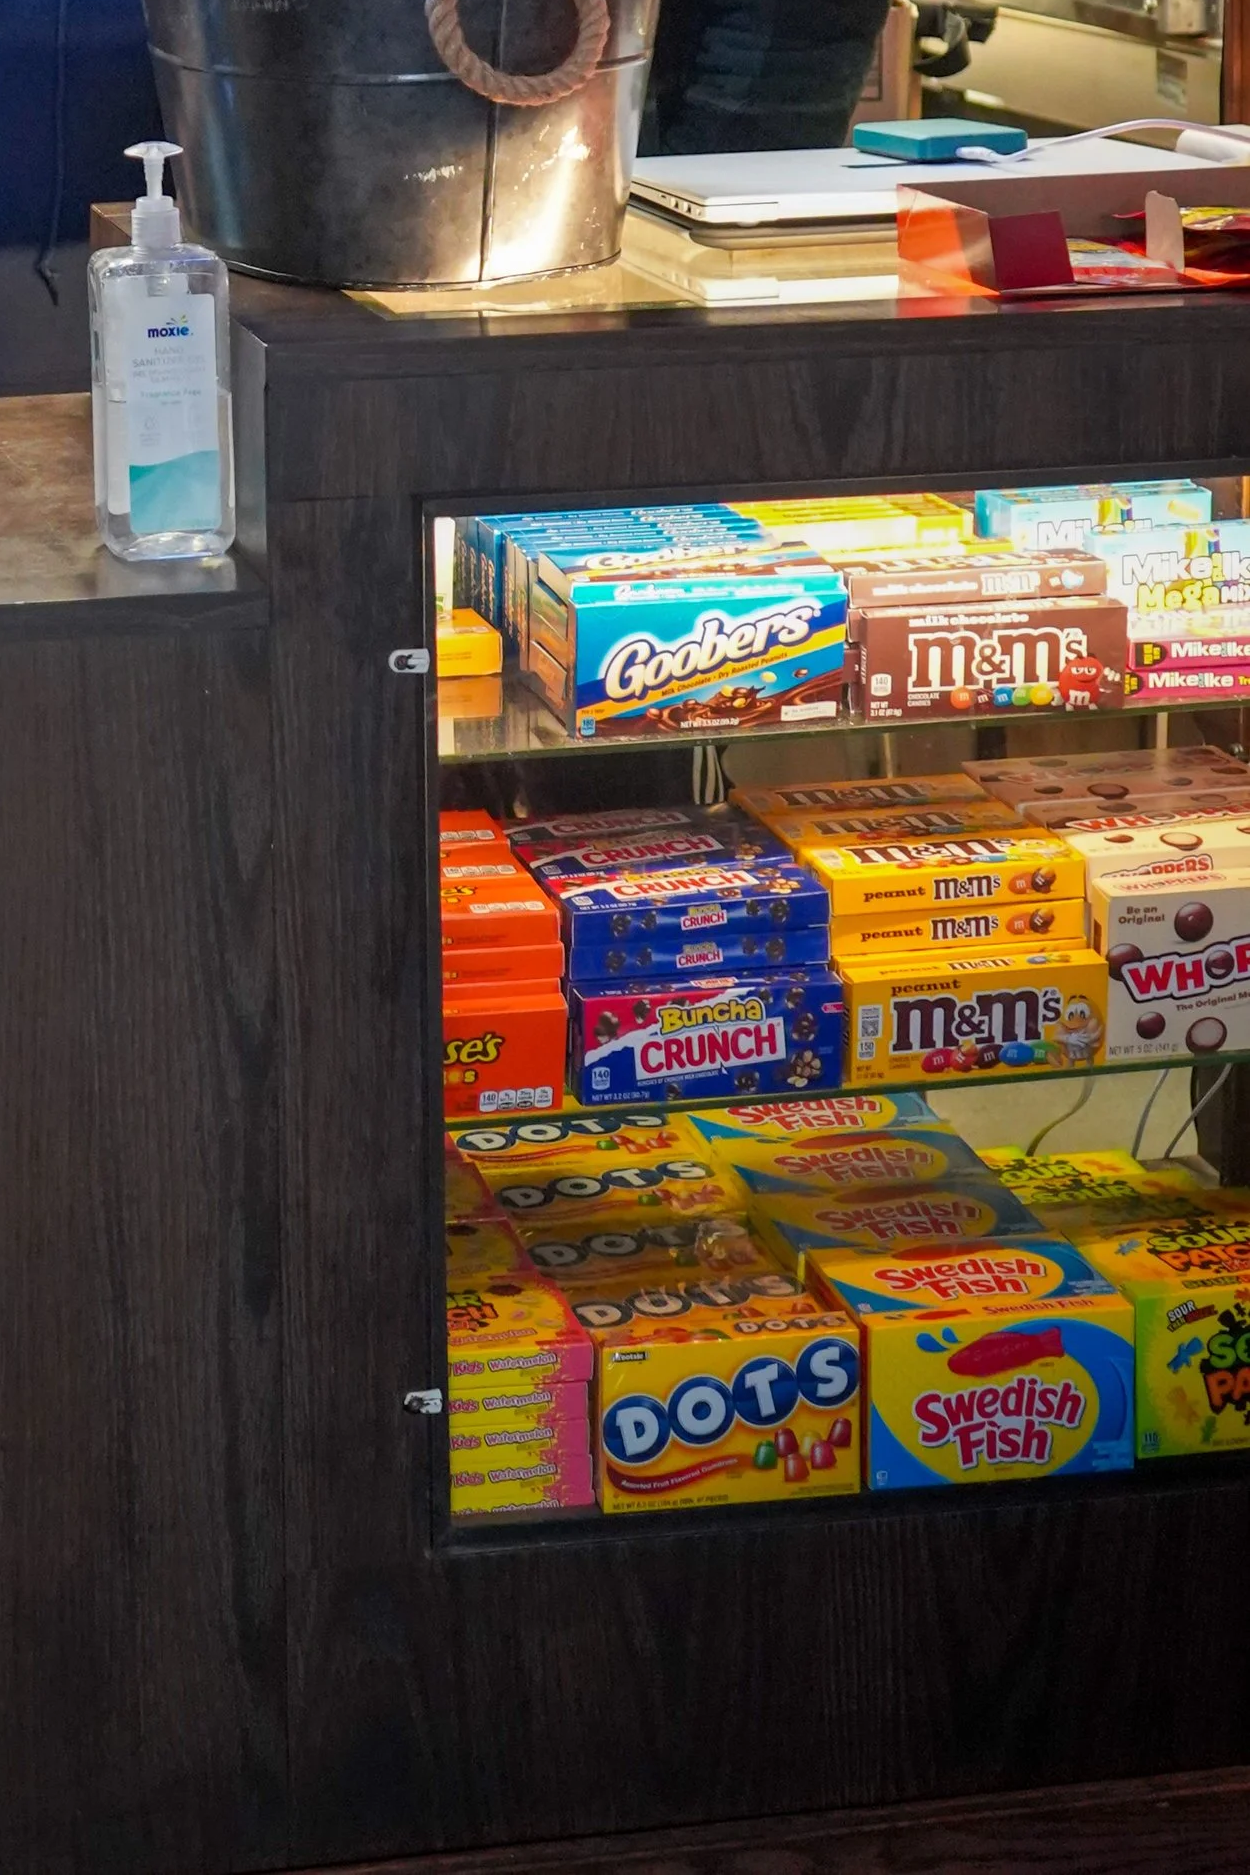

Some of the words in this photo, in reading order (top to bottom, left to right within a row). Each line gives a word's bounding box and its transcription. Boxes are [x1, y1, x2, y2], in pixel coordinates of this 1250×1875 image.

[147, 325, 190, 338] moxie
[1122, 550, 1212, 585] Mike
[1137, 579, 1220, 613] Mega
[908, 615, 949, 627] milk
[950, 613, 1029, 626] chocolate
[603, 604, 815, 704] Goobers
[909, 628, 1087, 691] m&m's
[1170, 641, 1222, 658] Mike
[677, 675, 712, 694] Chocolate
[732, 661, 759, 675] Roasted
[761, 651, 788, 667] Peanuts
[875, 676, 889, 687] 140
[1148, 672, 1199, 688] Mike
[1204, 672, 1234, 687] Ike
[1069, 690, 1091, 707] m
[552, 812, 688, 834] CRUNCH
[581, 835, 719, 866] CRUNCH
[845, 838, 1016, 865] m&m's
[614, 871, 748, 897] CRUNCH
[863, 885, 926, 903] peanut
[933, 875, 1001, 901] m&m's
[682, 913, 726, 928] CRUNCH
[1118, 914, 1166, 925] Original
[1126, 906, 1141, 915] Be
[1143, 906, 1158, 914] an
[860, 926, 923, 943] peanut
[931, 915, 1000, 941] m&m's
[677, 952, 721, 966] CRUNCH
[891, 979, 962, 997] peanut
[1176, 1003, 1194, 1012] The
[1195, 993, 1237, 1008] Original
[659, 998, 763, 1034] Buncha
[892, 988, 1063, 1053] m&m's
[640, 1022, 778, 1074] CRUNCH
[860, 1042, 874, 1050] 150
[1109, 1045, 1123, 1056] NET
[592, 1070, 610, 1080] 140
[482, 1093, 496, 1103] 140
[728, 1096, 882, 1126] Swedish
[772, 1109, 866, 1133] Fish
[461, 1113, 664, 1150] DOTS
[773, 1145, 933, 1173] Swedish
[818, 1159, 917, 1182] Fish
[503, 1161, 710, 1208] DOTS
[815, 1198, 983, 1230] Swedish
[861, 1216, 964, 1241] Fish
[874, 1257, 1048, 1293] Swedish
[928, 1273, 1031, 1303] Fish
[576, 1275, 801, 1327] DOTS
[981, 1299, 1055, 1316] Swedish
[1055, 1296, 1095, 1312] Fish
[1168, 1299, 1196, 1323] SOUR
[488, 1352, 558, 1373] Watermelon
[482, 1391, 551, 1411] Watermelon
[610, 1342, 853, 1460] DOTS
[914, 1377, 1083, 1444] Swedish
[485, 1427, 554, 1447] Watermelon
[953, 1419, 1050, 1467] Fish
[488, 1463, 557, 1483] Watermelon
[621, 1479, 652, 1489] Assorted
[653, 1479, 670, 1489] Fruit
[671, 1470, 701, 1485] Flavored
[701, 1457, 739, 1474] Gumdrops
